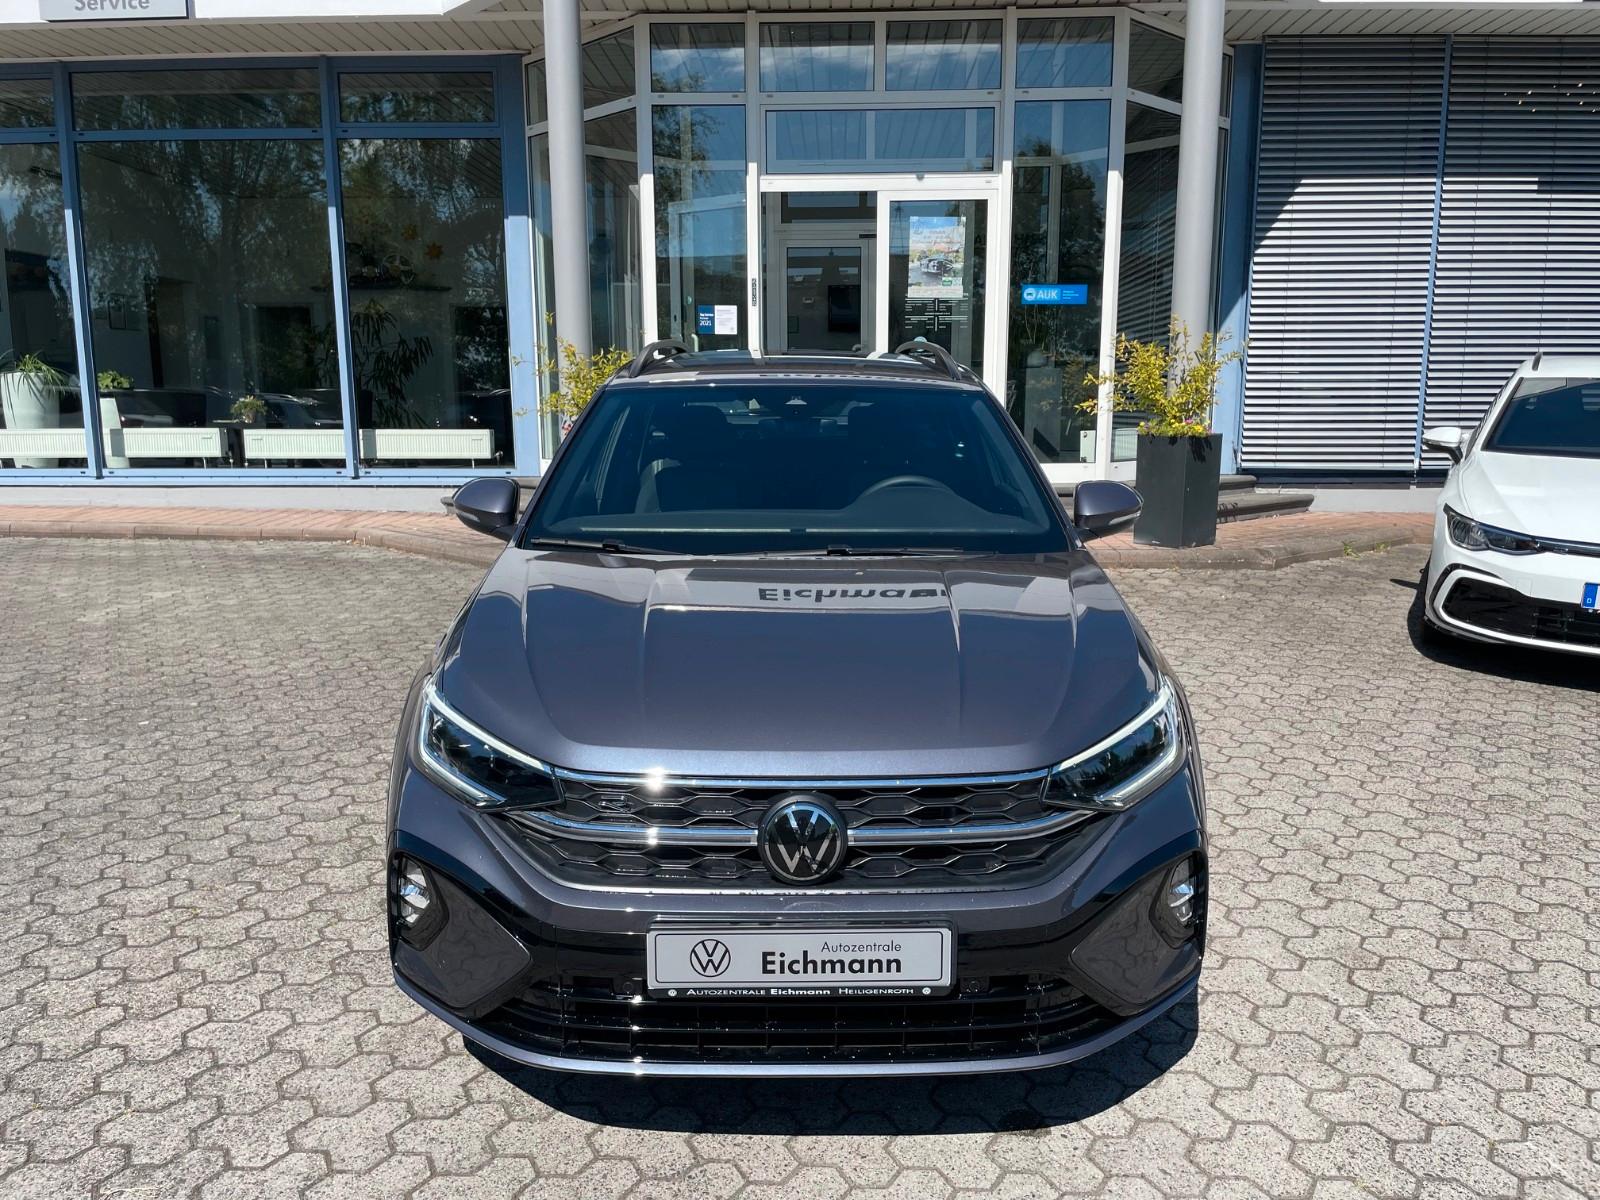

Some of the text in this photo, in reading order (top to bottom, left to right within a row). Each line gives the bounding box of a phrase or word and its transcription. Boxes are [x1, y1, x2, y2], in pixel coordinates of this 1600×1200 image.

[74, 0, 150, 11] Service
[1036, 289, 1058, 300] AUK
[821, 940, 902, 953] Autozentrale
[690, 938, 731, 977] VW
[761, 950, 902, 975] Eichmann
[686, 988, 766, 996] AUTOZENTRALE
[838, 987, 914, 995] HEILIGENROTH
